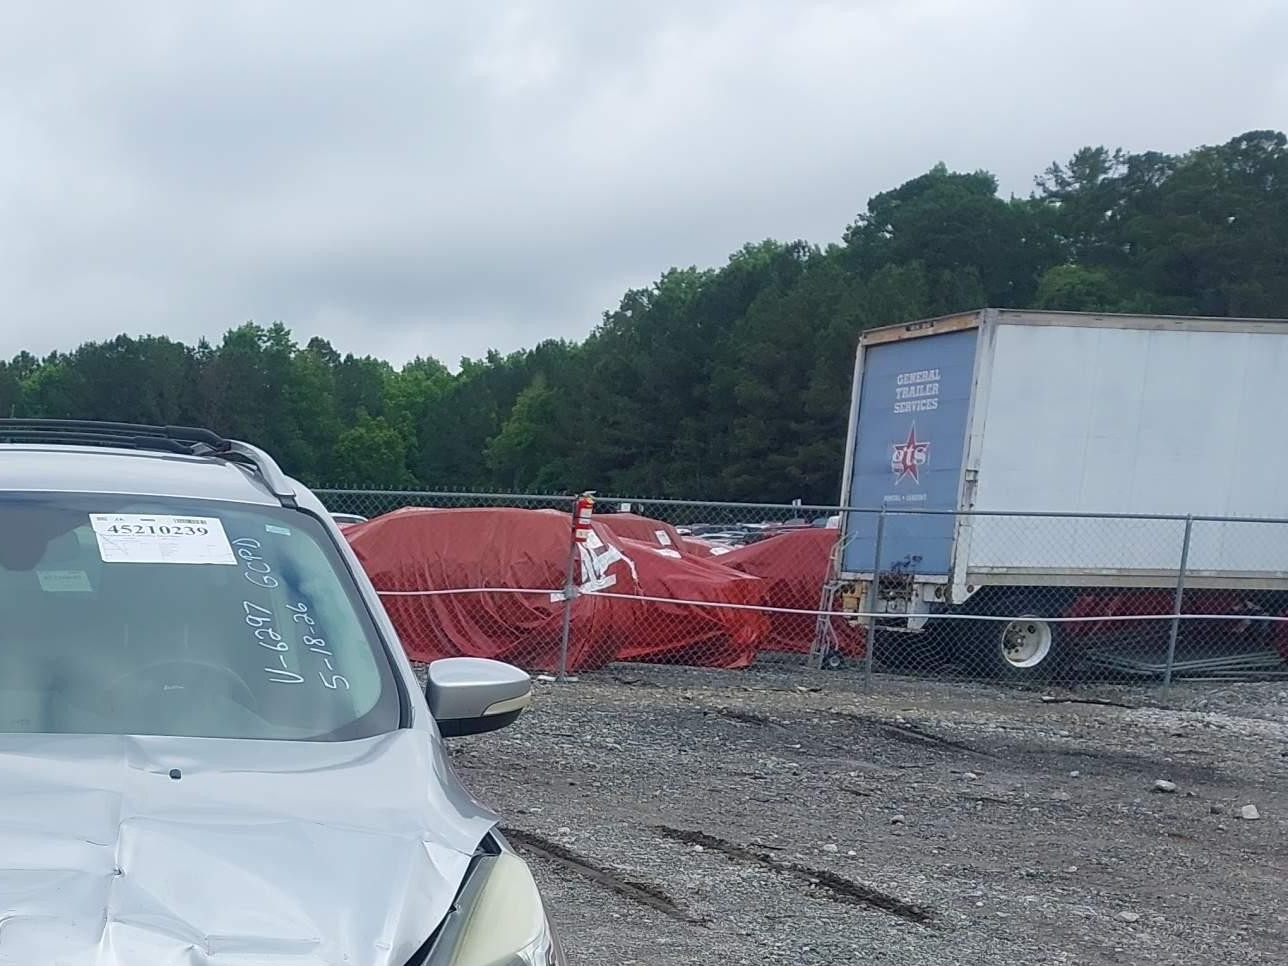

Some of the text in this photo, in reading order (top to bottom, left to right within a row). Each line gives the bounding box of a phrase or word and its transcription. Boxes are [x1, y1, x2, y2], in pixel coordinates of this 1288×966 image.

[897, 369, 941, 385] GENERAL
[896, 383, 939, 400] TRAILER
[893, 398, 938, 413] SERVICES
[107, 524, 209, 536] 45210239
[231, 537, 279, 588] GCPD
[285, 602, 350, 690] 5-18-26
